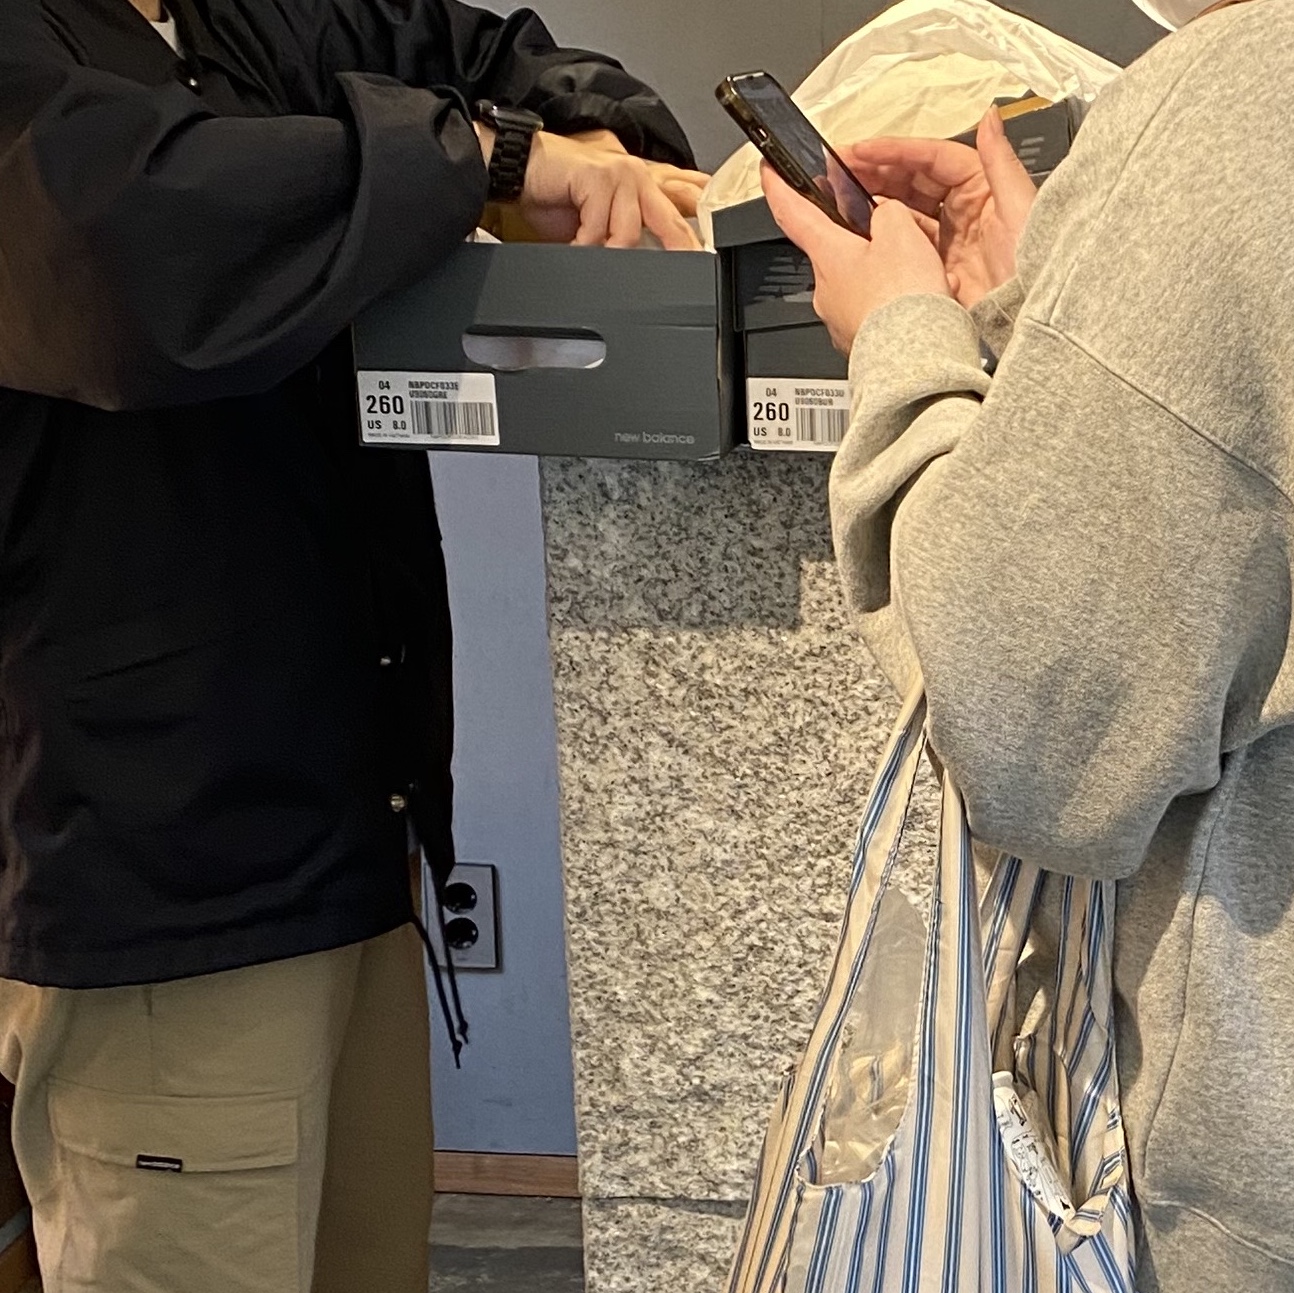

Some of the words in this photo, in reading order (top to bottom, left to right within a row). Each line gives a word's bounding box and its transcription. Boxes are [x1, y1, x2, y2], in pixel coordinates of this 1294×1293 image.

[378, 381, 390, 390] 04
[766, 388, 777, 397] 04
[366, 395, 404, 415] 260
[753, 402, 789, 421] 260
[367, 420, 382, 429] US
[393, 421, 407, 430] 8.0
[753, 427, 767, 436] US
[778, 428, 791, 437] 8.0
[614, 433, 640, 442] new
[642, 431, 695, 444] balance
